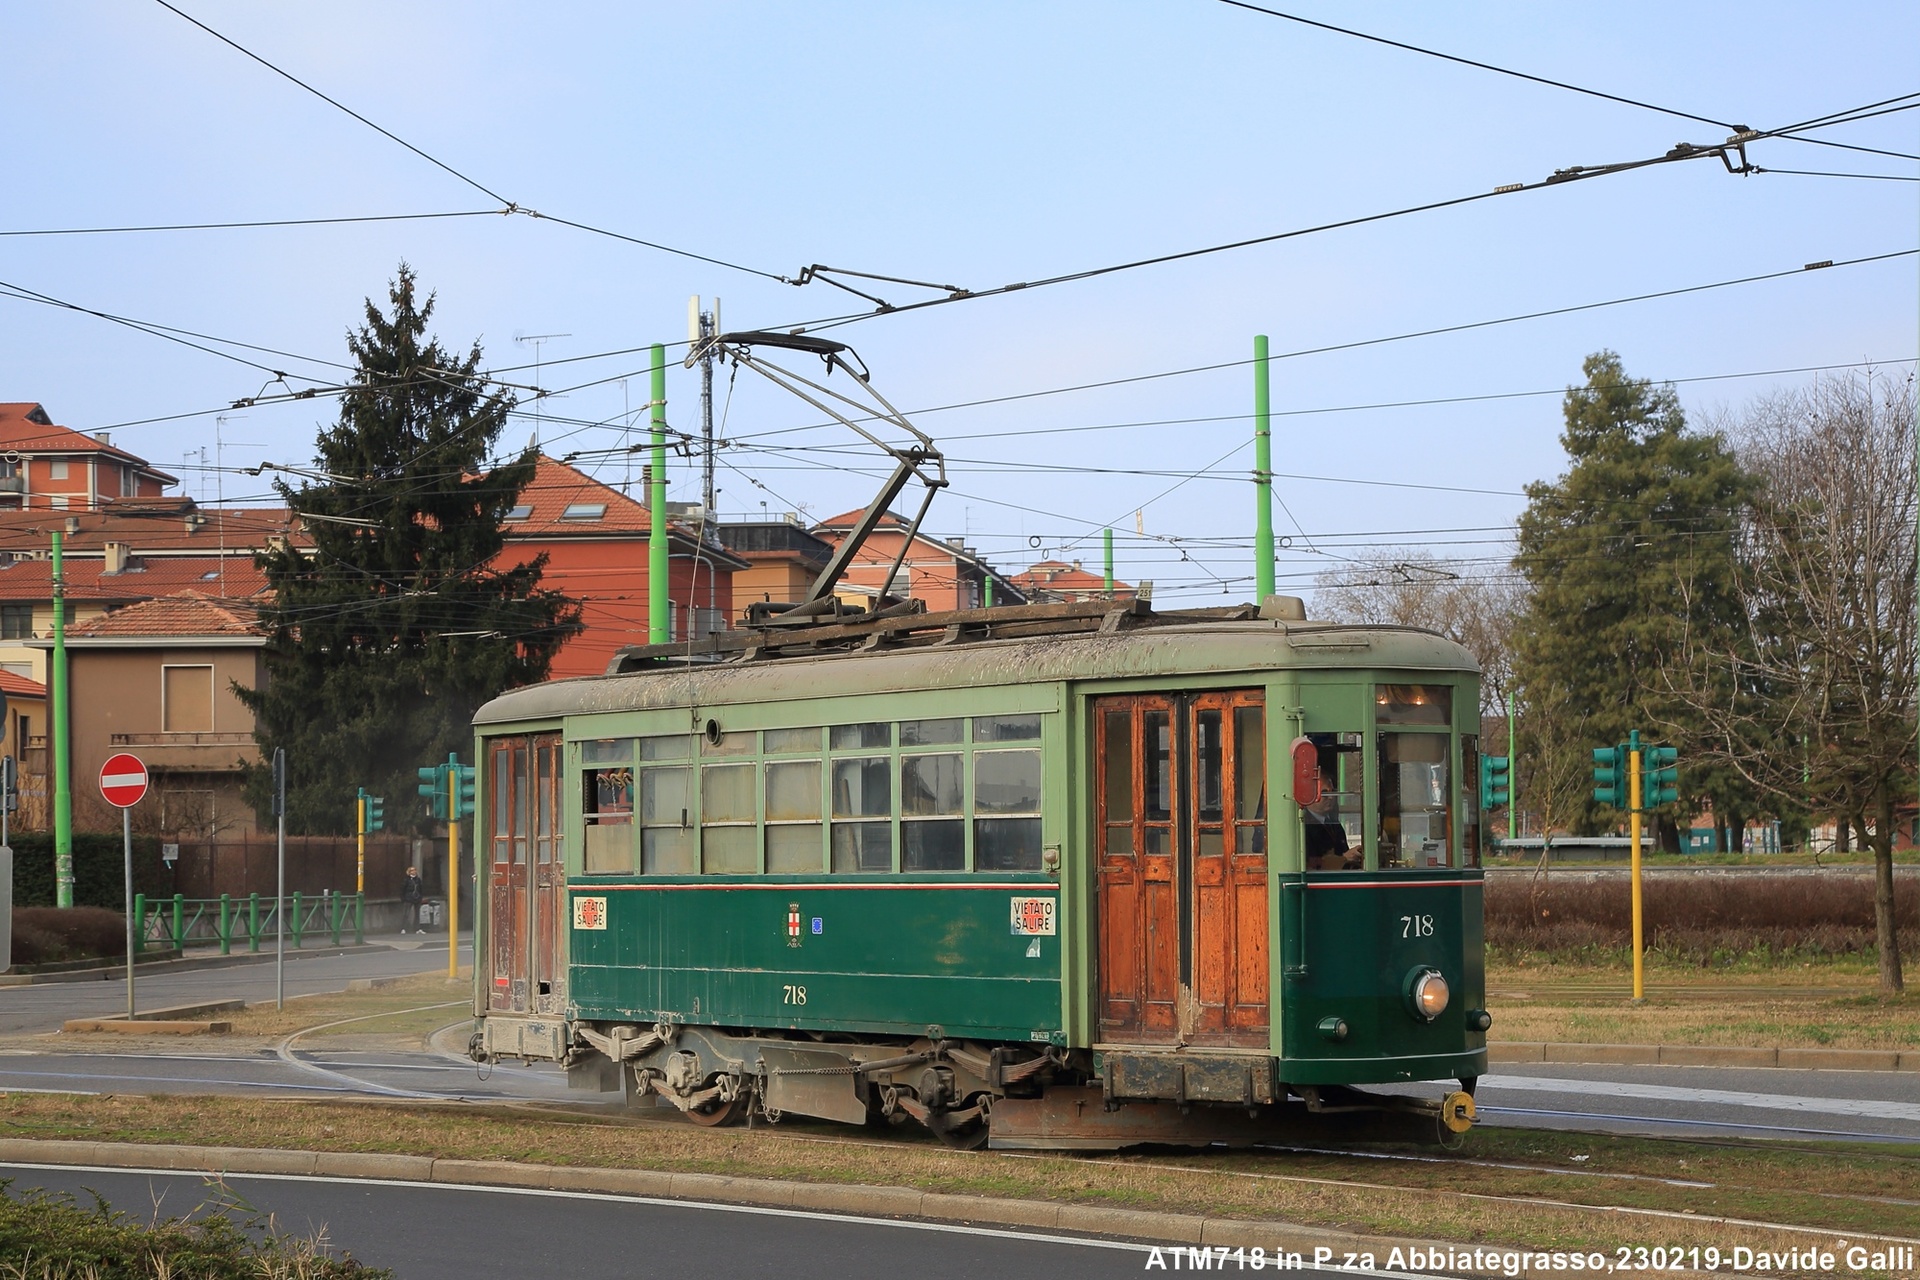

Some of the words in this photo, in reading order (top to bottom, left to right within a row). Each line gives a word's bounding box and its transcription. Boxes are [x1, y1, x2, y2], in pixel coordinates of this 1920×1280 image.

[576, 901, 605, 912] VIETATO
[1013, 902, 1053, 915] VIETATO
[577, 914, 602, 926] SALIRE
[1015, 917, 1049, 930] SALIRE
[1400, 914, 1434, 939] 718
[782, 984, 807, 1006] 718
